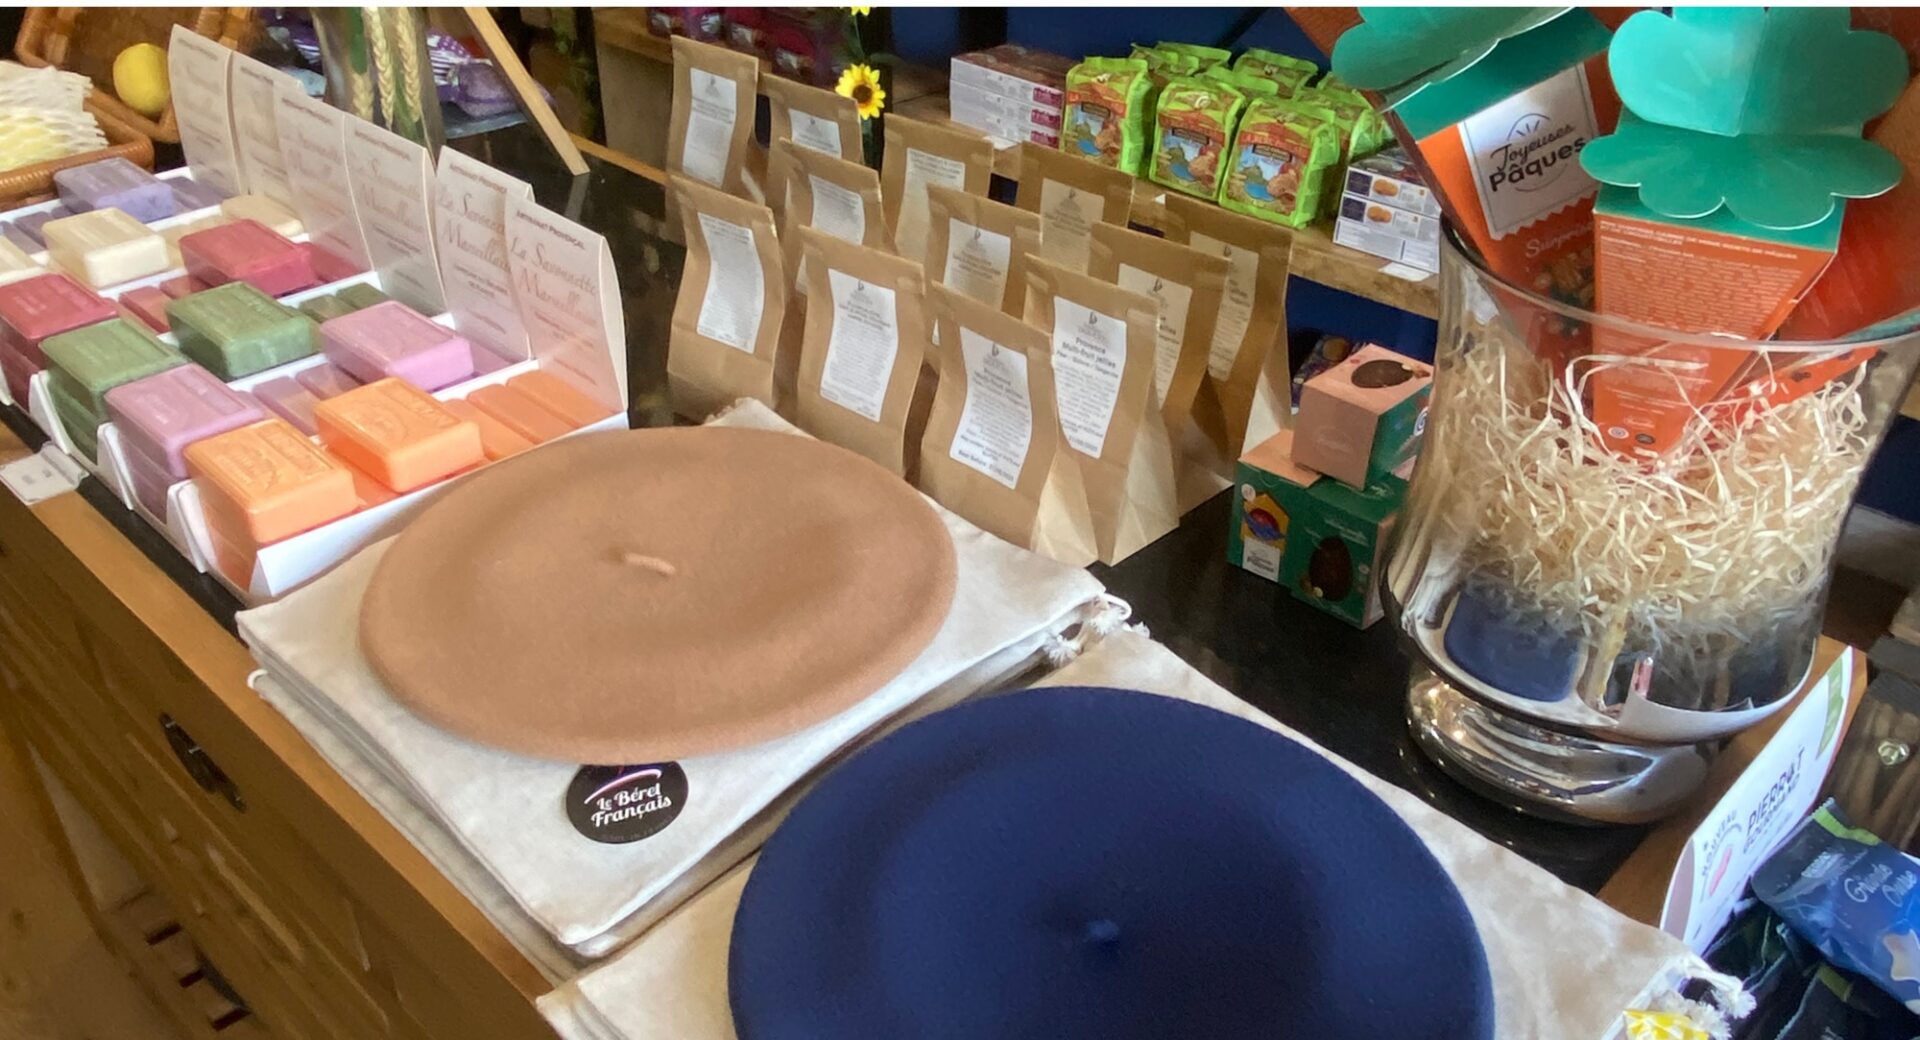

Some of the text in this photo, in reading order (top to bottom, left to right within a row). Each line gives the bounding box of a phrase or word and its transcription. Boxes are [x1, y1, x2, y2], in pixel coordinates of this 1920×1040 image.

[1488, 137, 1586, 193] Pâques
[1490, 125, 1577, 172] Joyeuses
[590, 796, 672, 828] Français
[596, 782, 661, 811] Le Béret
